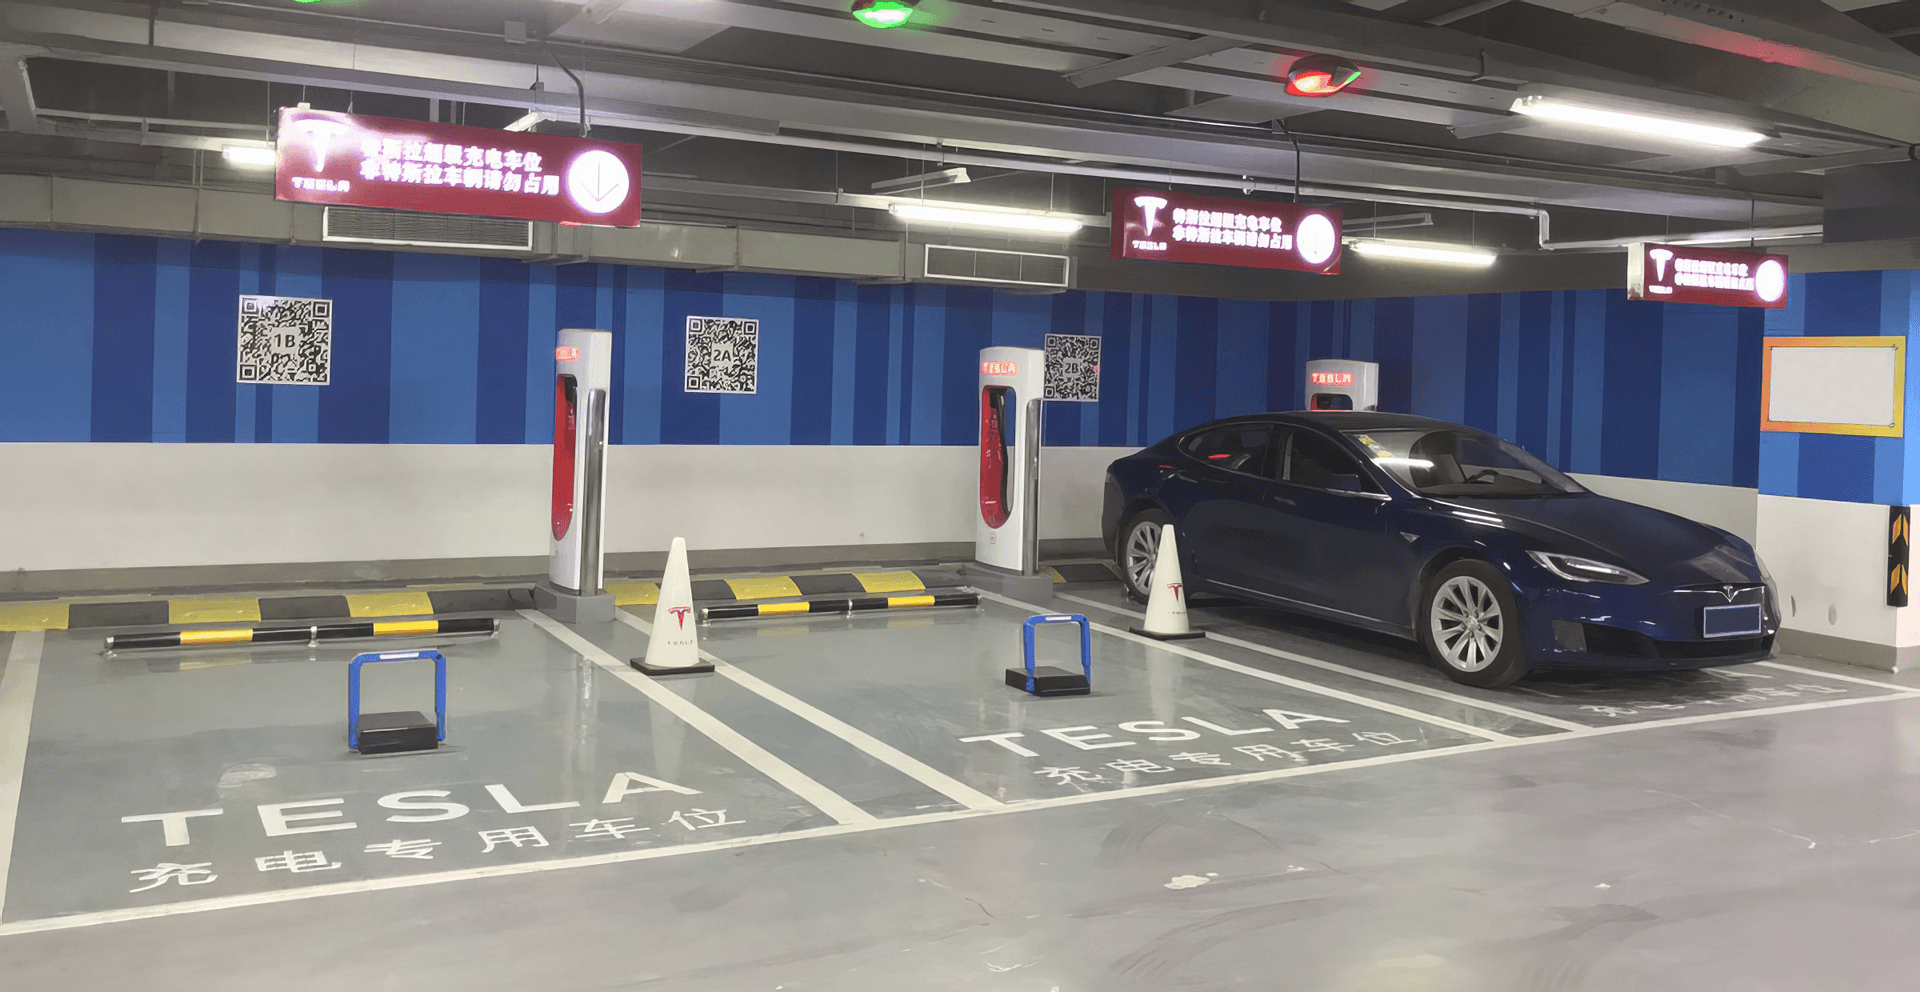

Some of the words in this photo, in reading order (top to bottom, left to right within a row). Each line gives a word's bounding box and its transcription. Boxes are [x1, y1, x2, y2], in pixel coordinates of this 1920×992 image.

[274, 334, 295, 348] 1B
[713, 349, 732, 361] 2A
[1064, 363, 1079, 374] 2B
[959, 708, 1351, 758] TESLA
[1033, 730, 1418, 785] 充电专用车位
[122, 771, 702, 846] TESLA
[129, 808, 746, 892] 充电专用车位
